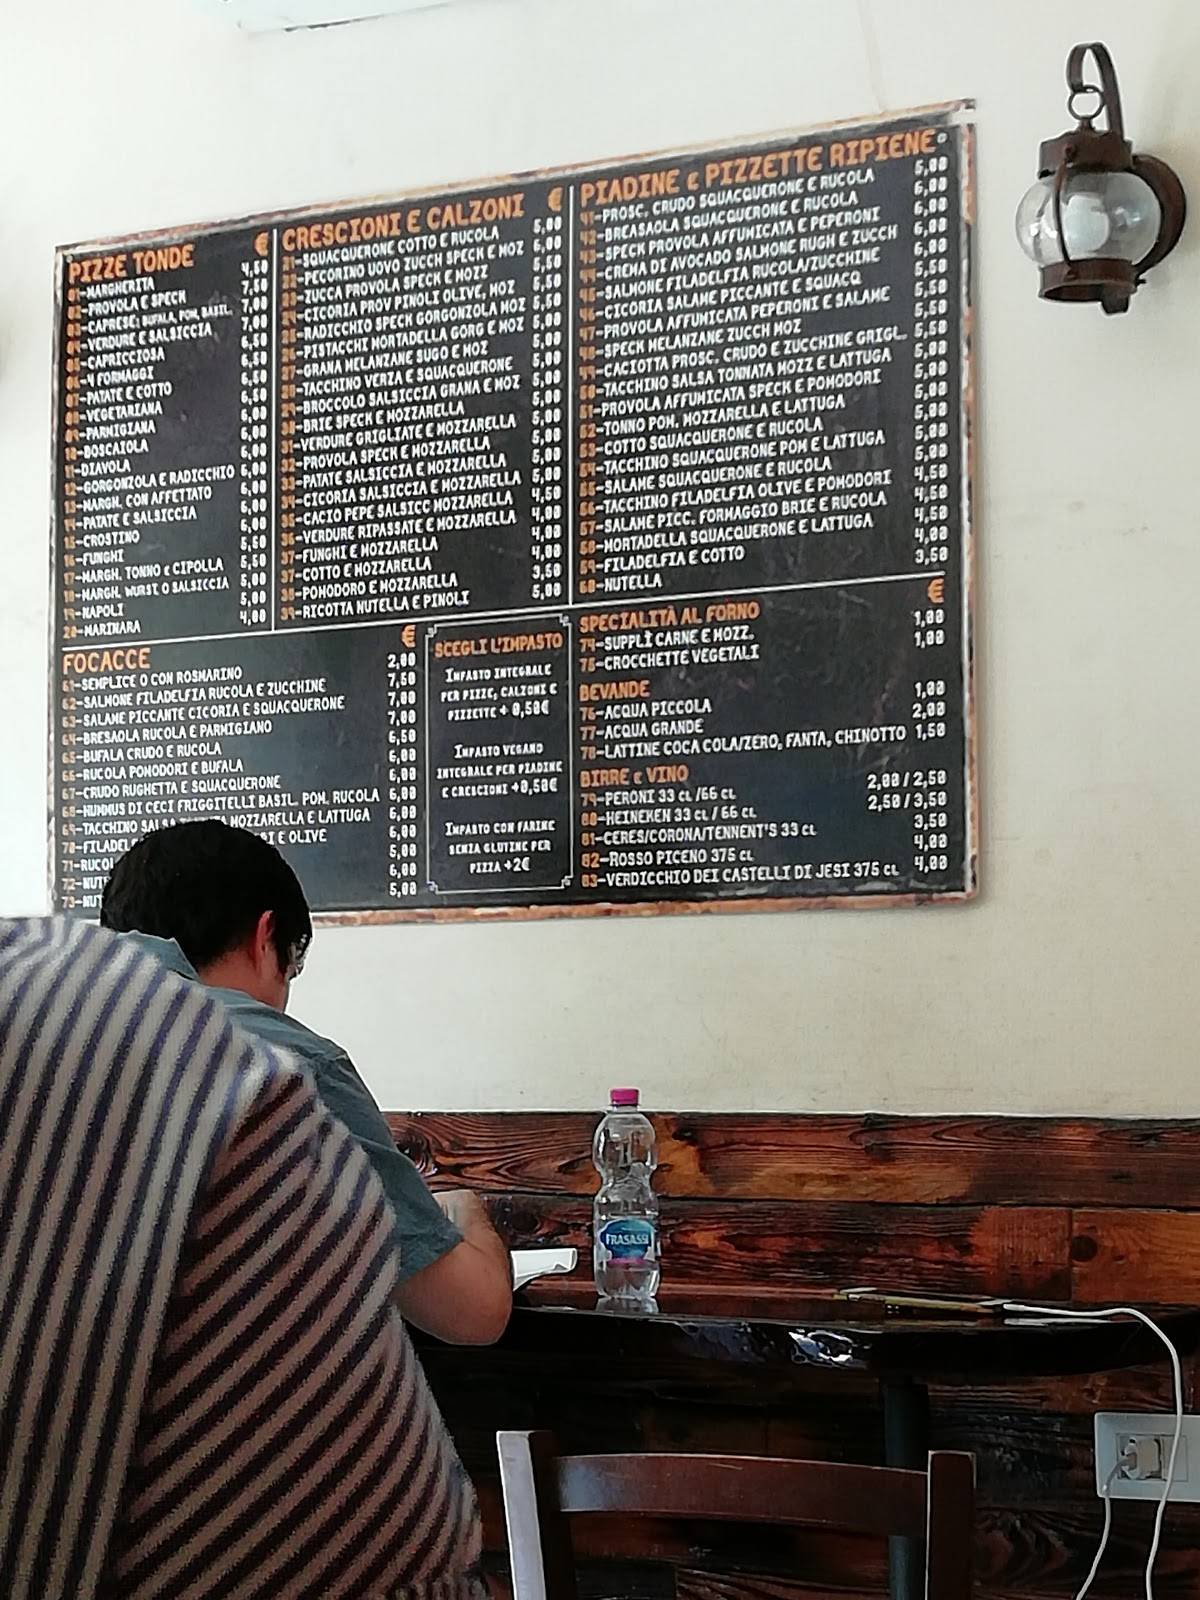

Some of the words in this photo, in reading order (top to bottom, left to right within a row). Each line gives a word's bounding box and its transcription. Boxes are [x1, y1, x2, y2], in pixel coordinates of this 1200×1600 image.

[282, 212, 402, 251] CRESCIONI
[406, 209, 420, 232] E
[427, 193, 525, 230] CALZONI
[68, 255, 127, 284] PIZZE
[134, 244, 194, 273] TONDE
[648, 413, 679, 431] POM.
[682, 402, 769, 427] MOZZARELLA
[771, 400, 781, 416] E
[784, 393, 845, 414] LATTUGA
[914, 381, 947, 400] 5,00
[355, 423, 423, 446] GRIGLIATE
[425, 422, 434, 438] E
[436, 413, 516, 436] MOZZARELLA
[531, 407, 561, 425] 5,00
[649, 423, 753, 450] SQUACQUERONE
[756, 422, 766, 438] E
[768, 416, 823, 437] RUCOLA
[914, 401, 947, 421] 5,00
[360, 446, 398, 464] SPECK
[400, 444, 409, 459] E
[411, 435, 490, 458] MOZZARELLA
[531, 427, 561, 444] 5,00
[158, 472, 167, 486] E
[169, 464, 235, 485] RADICCHIO
[240, 460, 267, 477] 6,00
[345, 463, 413, 484] SALSICCIA
[415, 461, 425, 476] E
[427, 452, 506, 475] MOZZARELLA
[531, 446, 561, 464] 5,00
[125, 492, 149, 508] CON
[150, 485, 212, 506] AFFETTATO
[240, 479, 267, 495] 6,00
[671, 484, 755, 507] FILADELFIA
[757, 478, 802, 497] OLIVE
[804, 477, 815, 493] E
[817, 468, 891, 492] POMODORI
[914, 463, 947, 483] 4,50
[122, 511, 130, 526] E
[132, 505, 197, 525] SALSICCIA
[240, 497, 267, 514] 6,00
[344, 504, 375, 522] PEPE
[433, 490, 513, 513] MOZZARELLA
[531, 485, 561, 502] 4,50
[240, 516, 267, 532] 6,00
[688, 549, 698, 565] E
[700, 545, 744, 563] COTTO
[914, 525, 948, 544] 4,00
[356, 595, 409, 614] NUTELLA
[411, 594, 420, 609] E
[423, 590, 469, 609] PINOLI
[531, 582, 561, 599] 5,00
[239, 608, 266, 625] 4,00
[579, 605, 678, 633] SPECIALITÀ
[680, 606, 702, 625] AL
[705, 601, 760, 623] FORNO
[654, 628, 698, 647] CARNE
[701, 627, 711, 643] E
[713, 624, 754, 642] MOZZ.
[914, 608, 944, 627] 1,00
[62, 649, 150, 674] FOCACCE
[434, 639, 487, 659] SCEGLI
[491, 632, 563, 655] L'IMPASTO
[691, 644, 759, 663] VEGETALI
[914, 629, 944, 648] 1,00
[579, 679, 650, 702] BEVANDE
[651, 698, 712, 717] PICCOLA
[915, 680, 945, 699] 1,00
[128, 706, 185, 724] PICCANTE
[187, 702, 240, 720] CICORIA
[242, 702, 251, 716] E
[252, 695, 345, 715] SQUACQUERONE
[387, 690, 416, 707] 7,00
[651, 718, 703, 736] GRANDE
[912, 701, 945, 719] 2,00
[142, 725, 187, 741] RUCOLA
[189, 724, 197, 738] E
[199, 719, 272, 738] PARMIGIANO
[387, 709, 416, 726] 7,00
[663, 739, 700, 755] COCA
[786, 730, 832, 748] FANTA,
[835, 725, 906, 744] CHINOTTO
[915, 722, 945, 739] 1,50
[126, 745, 164, 760] CRUDO
[166, 744, 174, 758] E
[176, 741, 222, 757] RUCOLA
[388, 728, 416, 745] 6,50
[580, 767, 630, 788] BIRRE
[645, 764, 689, 783] VINO
[781, 822, 798, 837] 33
[914, 812, 947, 830] 3,50
[656, 848, 707, 865] PICENO
[711, 847, 736, 862] 375
[914, 833, 947, 850] 4,00
[693, 868, 719, 883] DEI
[722, 864, 791, 882] CASTELLI
[794, 864, 812, 879] DI
[815, 862, 850, 878] JESI
[853, 861, 879, 877] 375
[914, 854, 947, 871] 4,00
[606, 1233, 649, 1246] FRASASSI
